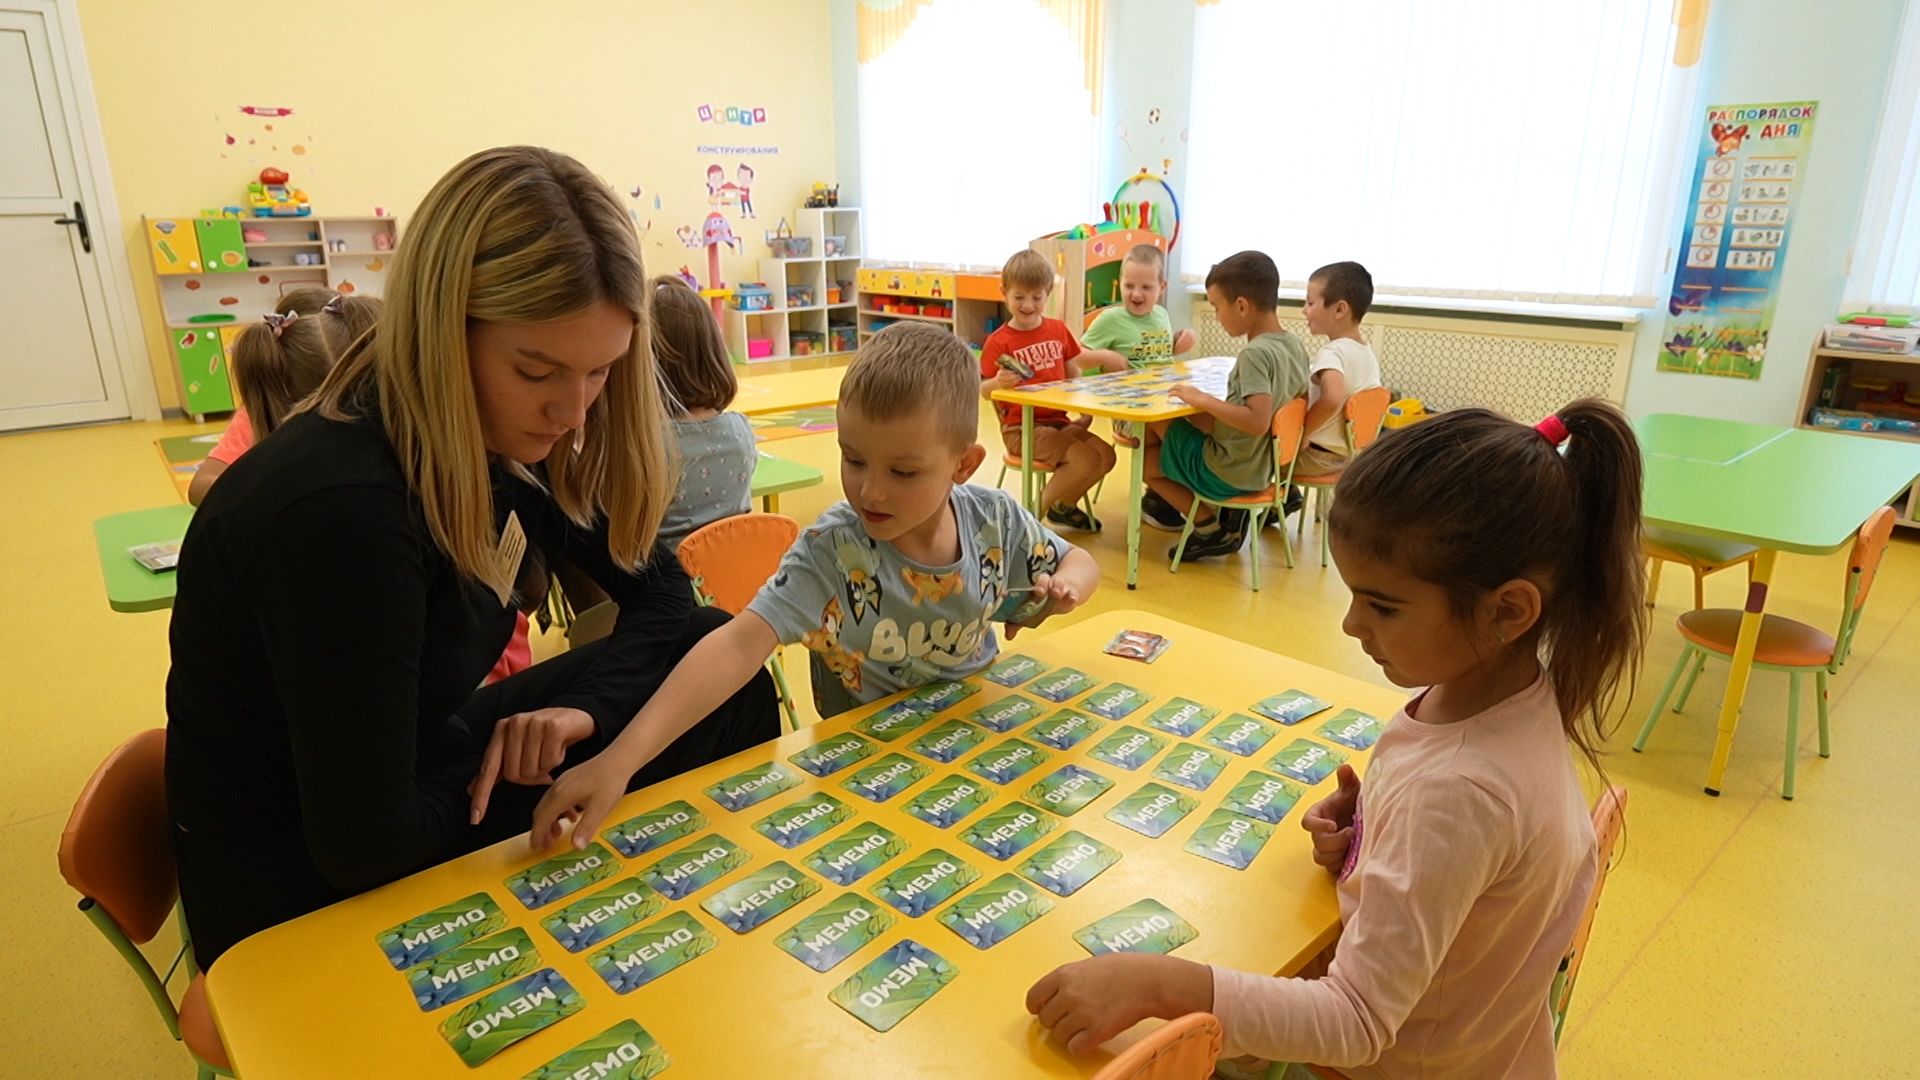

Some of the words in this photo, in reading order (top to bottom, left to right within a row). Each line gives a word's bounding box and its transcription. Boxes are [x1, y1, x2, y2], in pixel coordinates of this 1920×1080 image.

[1708, 107, 1814, 121] РАСПОРЯДОК
[1760, 124, 1800, 138] ДНЯ
[998, 659, 1035, 679] MEMO
[1043, 673, 1084, 694] MEMO
[922, 682, 963, 704] MEMO
[1099, 688, 1136, 711] MEMO
[1273, 696, 1313, 716] MEMO
[872, 707, 917, 732] MEMO
[986, 702, 1031, 724] MEMO
[1045, 715, 1086, 741] MEMO
[1166, 705, 1201, 729] MEMO
[1337, 717, 1375, 741] MEMO
[930, 727, 972, 754] MEMO
[1111, 733, 1150, 761] MEMO
[1224, 720, 1261, 747] MEMO
[811, 740, 861, 766] MEMO
[986, 747, 1033, 774] MEMO
[1177, 749, 1210, 781] MEMO
[1289, 746, 1327, 773] MEMO
[725, 771, 784, 799] MEMO
[862, 762, 913, 792] MEMO
[1045, 774, 1091, 803] MEMO
[925, 784, 976, 817] MEMO
[1130, 793, 1177, 825] MEMO
[1247, 780, 1283, 812] MEMO
[624, 811, 689, 844] MEMO
[775, 802, 834, 836] MEMO
[983, 812, 1037, 847] MEMO
[1211, 818, 1250, 855] MEMO
[663, 846, 728, 885] MEMO
[827, 834, 887, 873] MEMO
[1042, 843, 1097, 881] MEMO
[529, 855, 602, 893] MEMO
[896, 860, 958, 901] MEMO
[567, 892, 643, 934] MEMO
[729, 877, 796, 917] MEMO
[965, 889, 1028, 930] MEMO
[401, 907, 486, 951] MEMO
[803, 907, 871, 953] MEMO
[1103, 914, 1170, 953] MEMO
[615, 927, 693, 973] MEMO
[431, 946, 520, 989] MEMO
[859, 956, 929, 1009] MEMO
[466, 986, 556, 1040] MEMO
[563, 1042, 641, 1080] EMO
